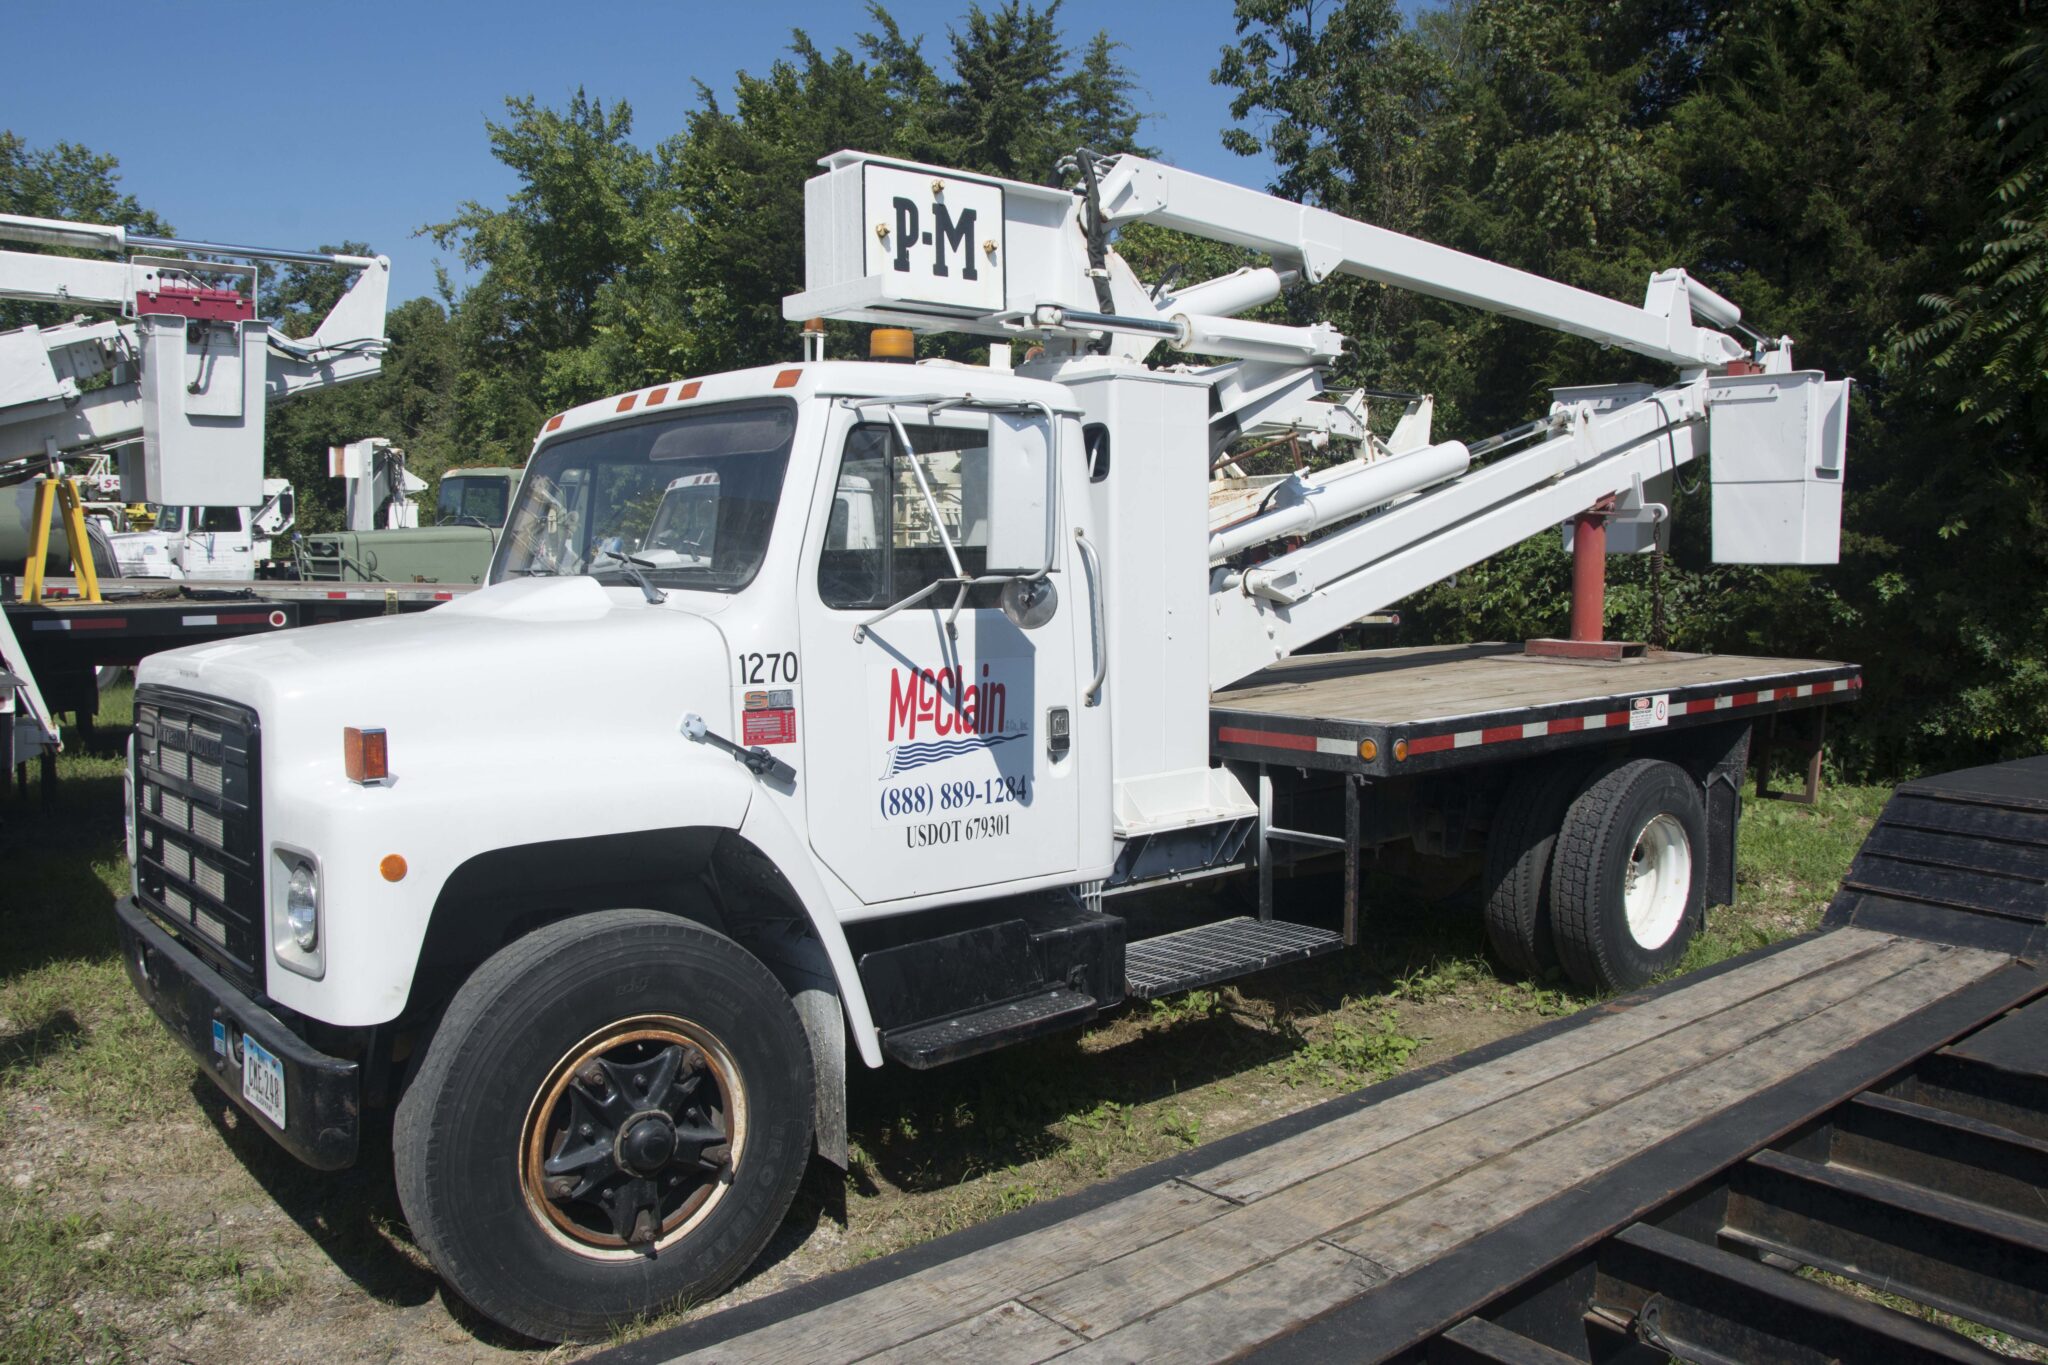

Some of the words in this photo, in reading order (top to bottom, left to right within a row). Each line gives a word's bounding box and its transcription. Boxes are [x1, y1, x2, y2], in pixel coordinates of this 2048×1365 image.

[893, 196, 978, 281] P-M
[739, 651, 798, 684] 1270
[888, 663, 1006, 742] McClain
[881, 783, 933, 820] (888)
[941, 775, 1027, 809] 889-1284
[906, 820, 961, 848] USDOT
[966, 814, 1010, 841] 679301
